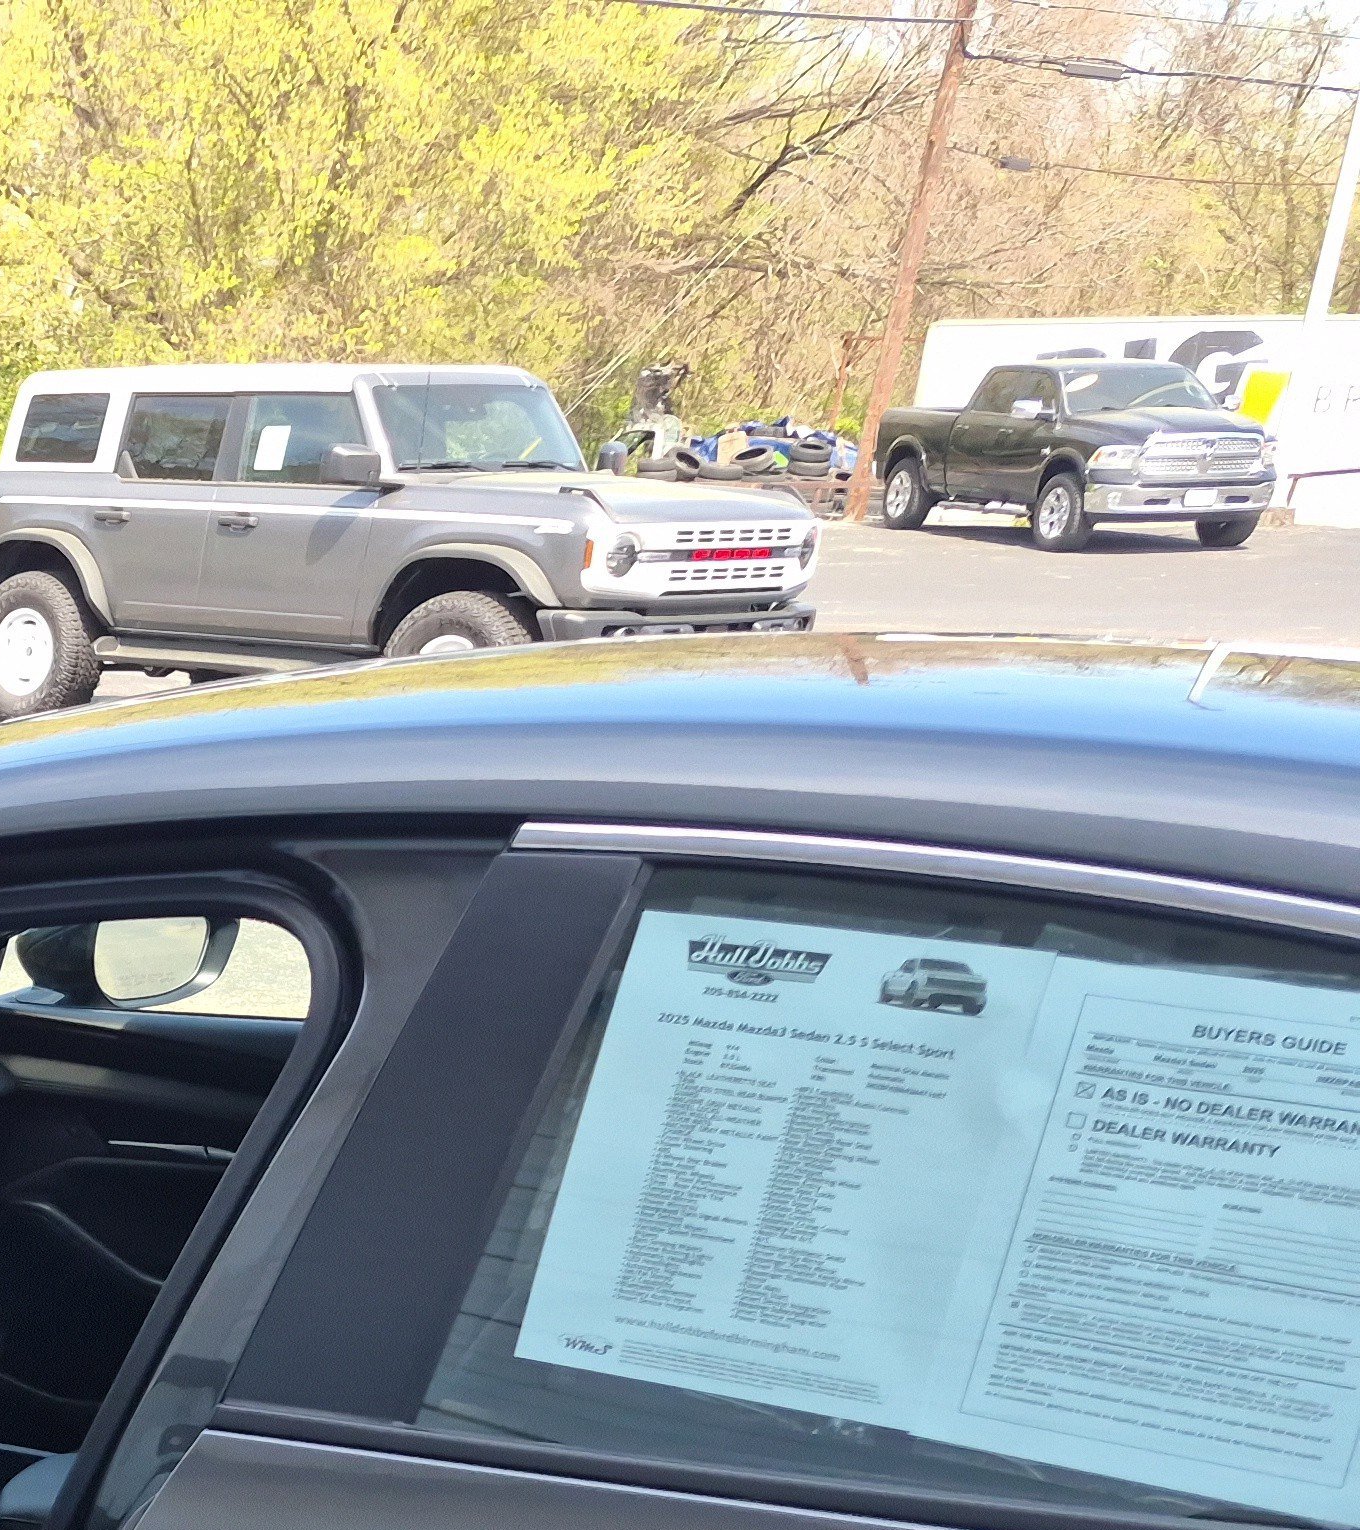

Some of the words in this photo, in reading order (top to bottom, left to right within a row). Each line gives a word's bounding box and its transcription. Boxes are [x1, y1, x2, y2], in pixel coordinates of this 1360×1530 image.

[658, 1012, 690, 1026] 2025
[691, 1016, 734, 1032] Mazda
[736, 1022, 787, 1038] Mazda3
[788, 1028, 830, 1044] Sedan
[916, 1044, 956, 1061] Sport
[1191, 1024, 1276, 1047] BUYERS
[1280, 1035, 1349, 1056] GUIDE
[1101, 1086, 1128, 1102] AS
[1132, 1090, 1150, 1106] IS
[1163, 1095, 1192, 1113] NO
[1196, 1100, 1274, 1124] DEALER
[1091, 1118, 1168, 1142] DEALER
[1170, 1127, 1282, 1158] WARRANTY
